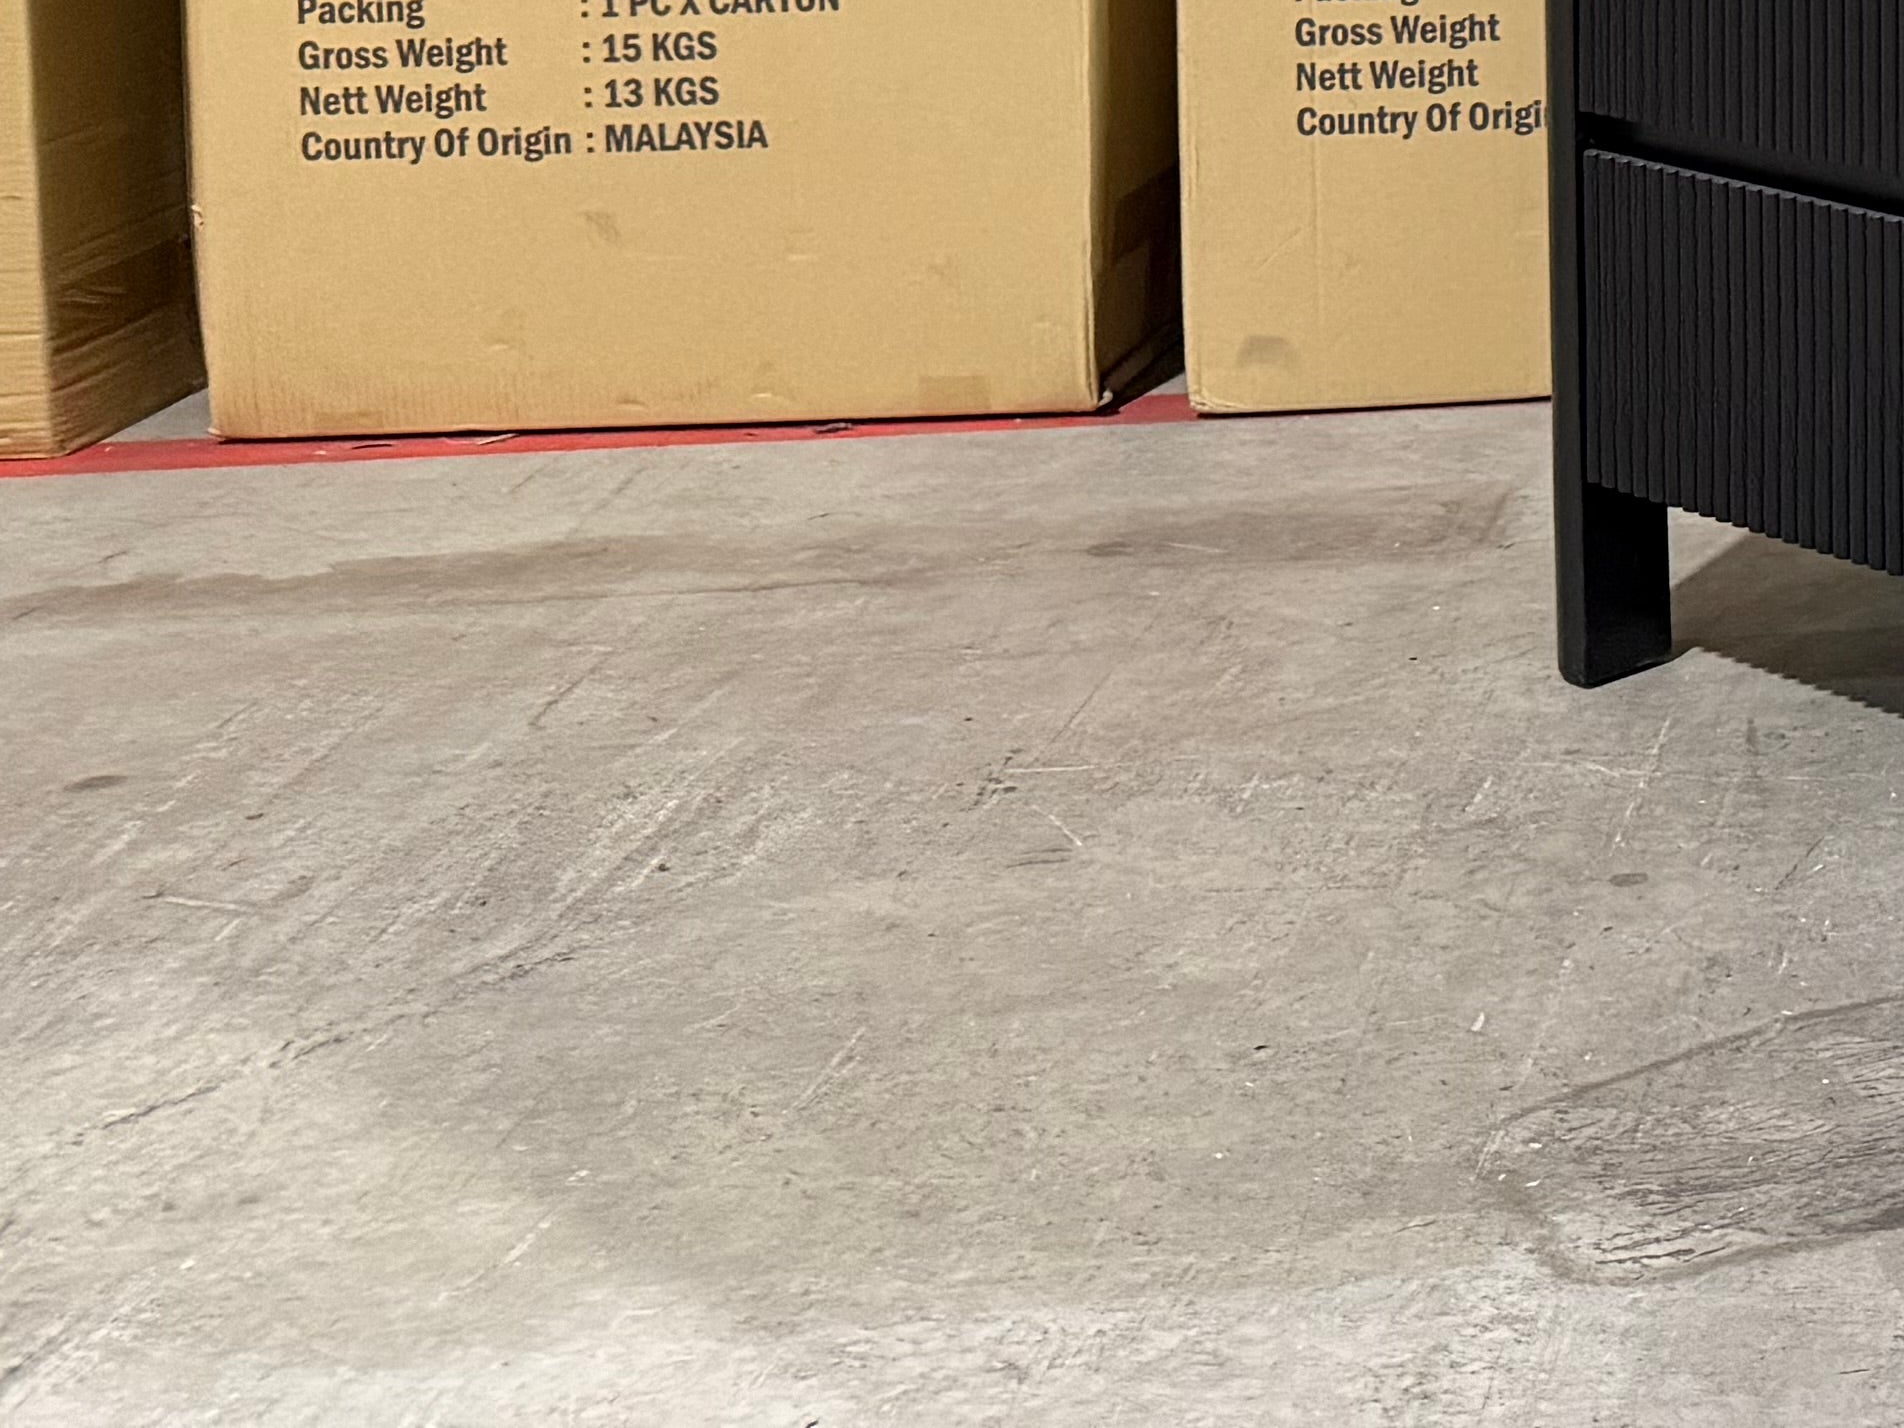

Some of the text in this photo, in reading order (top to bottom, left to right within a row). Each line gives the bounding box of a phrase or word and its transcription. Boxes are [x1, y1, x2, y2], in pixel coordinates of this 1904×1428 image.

[1295, 13, 1501, 49] Gross Weight
[298, 31, 717, 73] Gross Weight 15 KGS
[1297, 106, 1418, 140] Country
[1426, 102, 1461, 132] Of
[301, 120, 768, 165] Country Of Origin MALAYSIA
